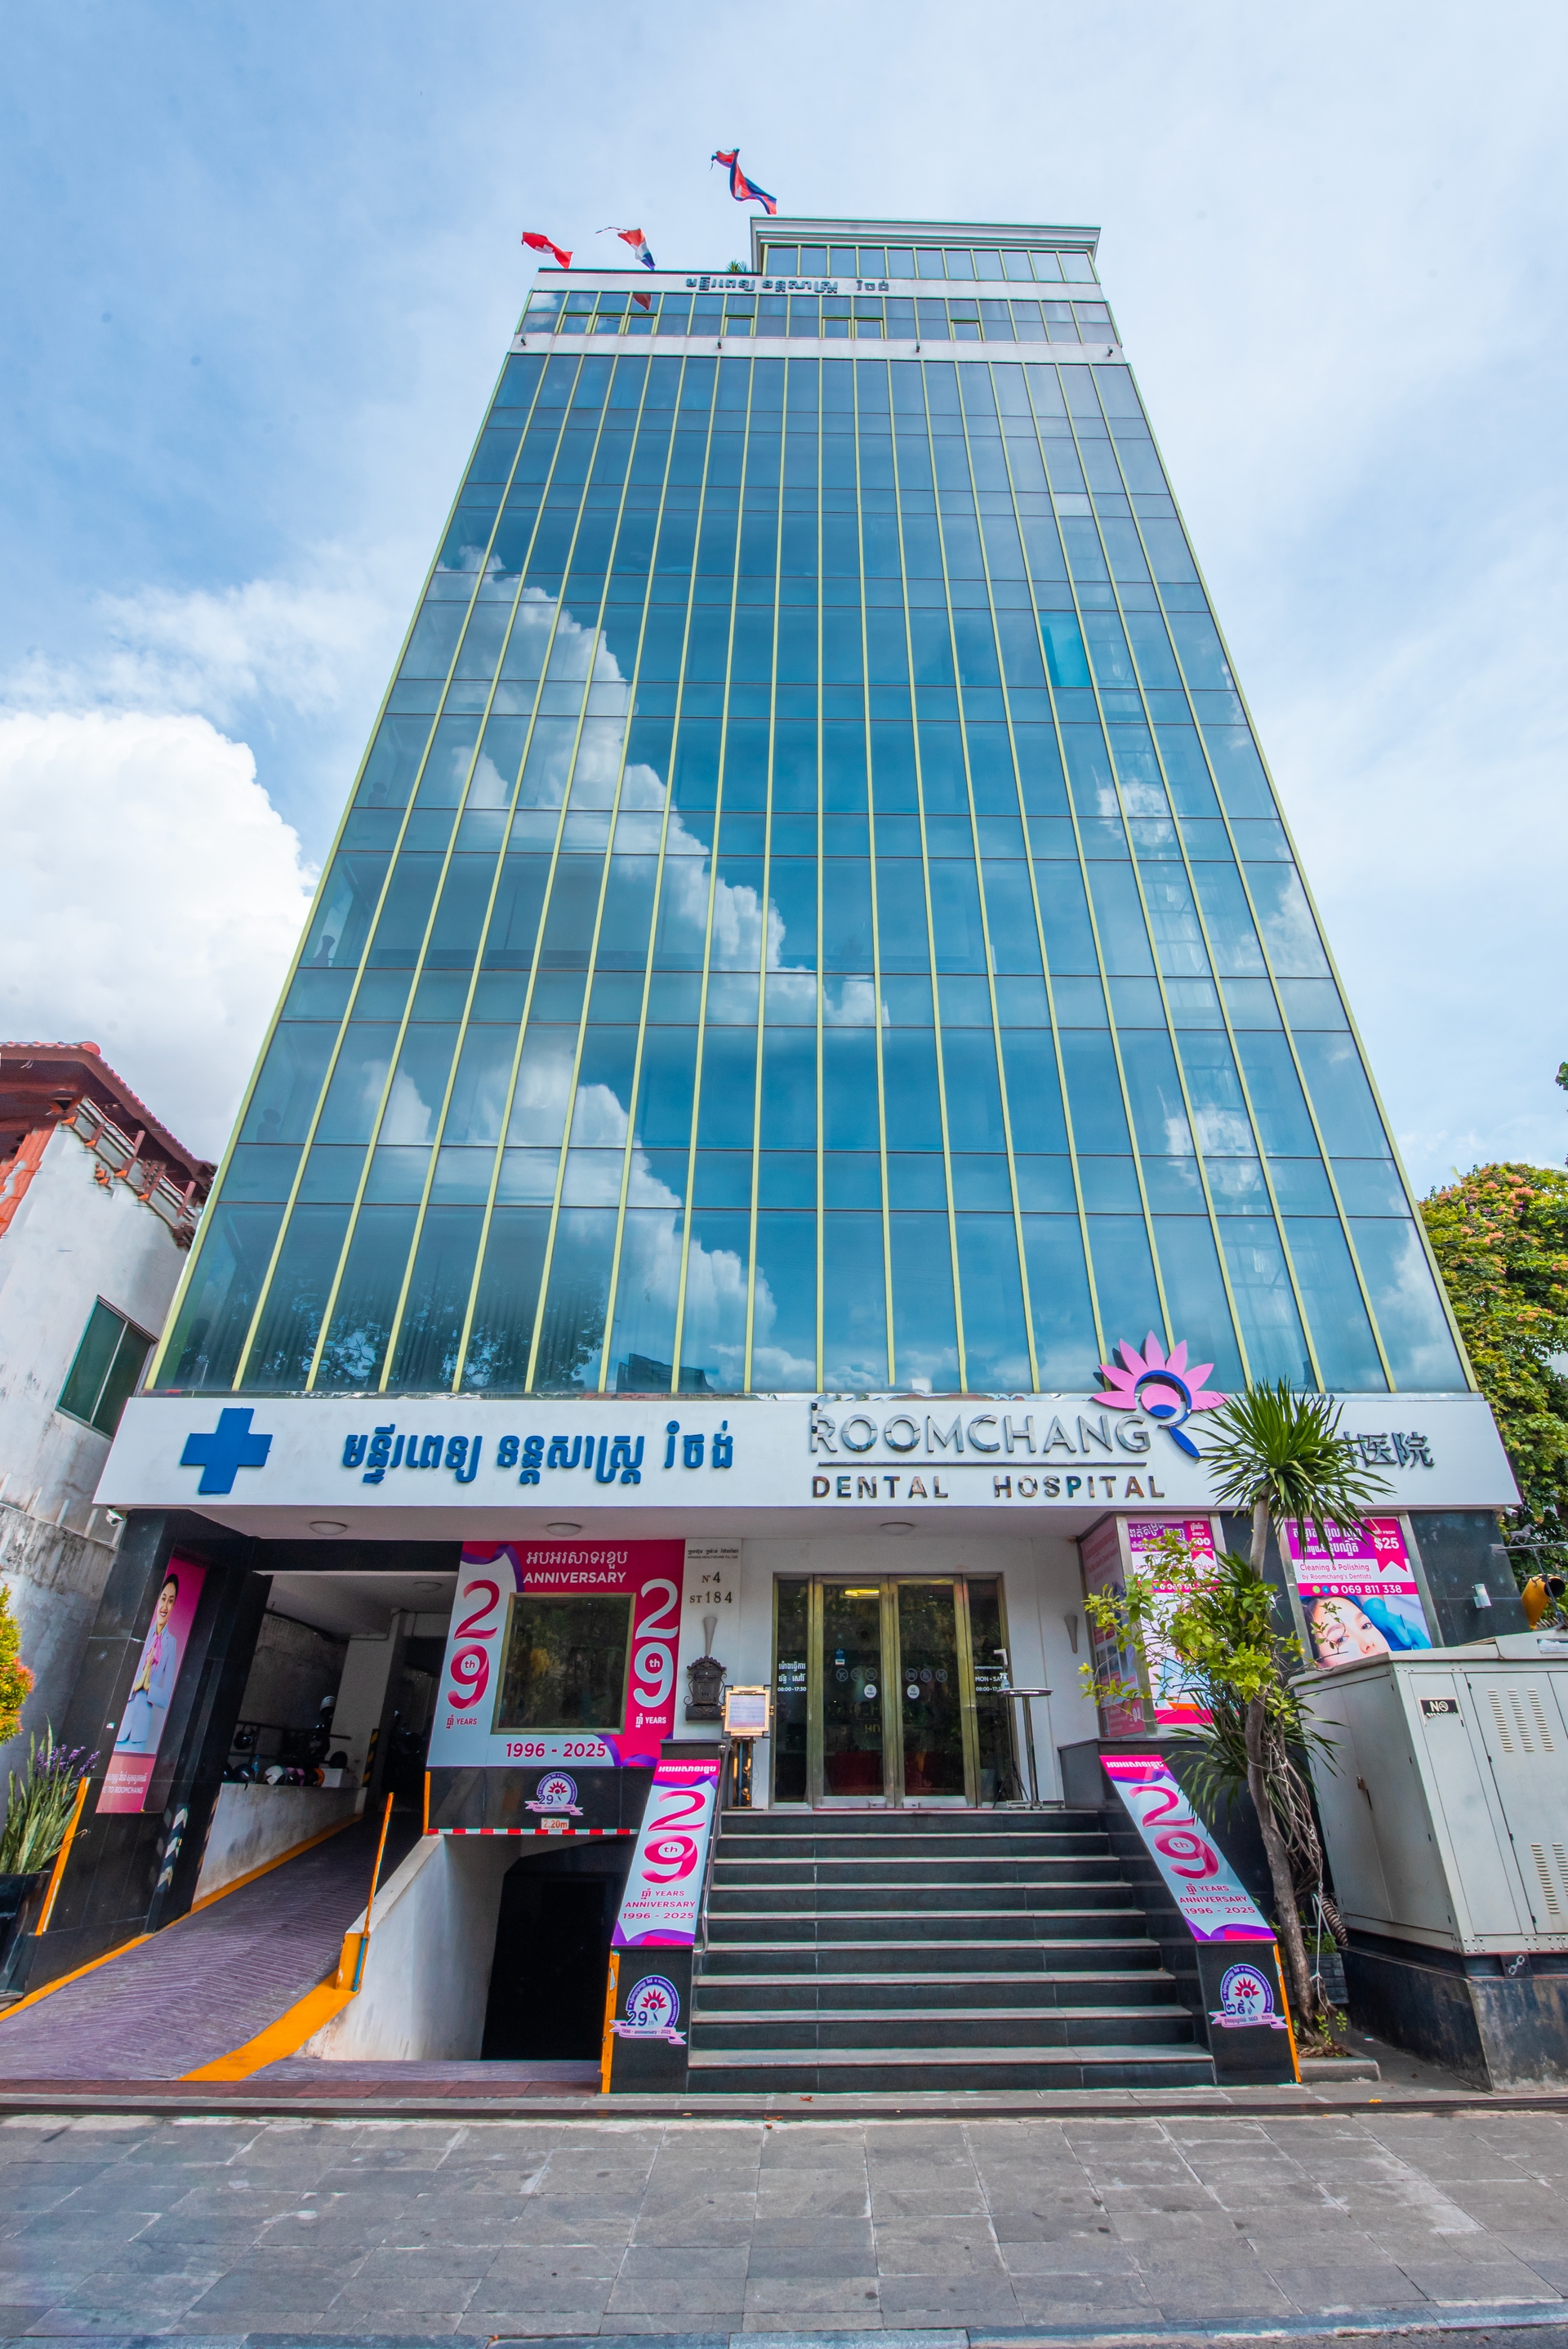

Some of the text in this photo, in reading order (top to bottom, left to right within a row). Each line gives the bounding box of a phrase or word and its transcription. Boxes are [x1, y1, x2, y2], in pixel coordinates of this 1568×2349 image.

[811, 1403, 1151, 1452] ROOMCHANG
[342, 1424, 483, 1484] មន្ទីរពេទ្យ
[813, 1475, 1165, 1498] DENTAL HOSPITAL
[1374, 1537, 1400, 1551] $25
[1300, 1564, 1330, 1572] Cleaning
[1339, 1563, 1370, 1571] Polishing
[523, 1572, 626, 1583] ANNIVERSARY
[713, 1571, 721, 1583] 4
[1365, 1585, 1380, 1593] 811
[1383, 1585, 1403, 1593] 338
[689, 1591, 733, 1603] ST 184
[464, 1660, 475, 1669] th
[649, 1659, 660, 1668] th
[506, 1742, 546, 1758] 1996
[562, 1742, 607, 1758] 2025
[539, 1794, 554, 1805] 29
[543, 1819, 568, 1829] 2.20m
[627, 2011, 648, 2026] 29
